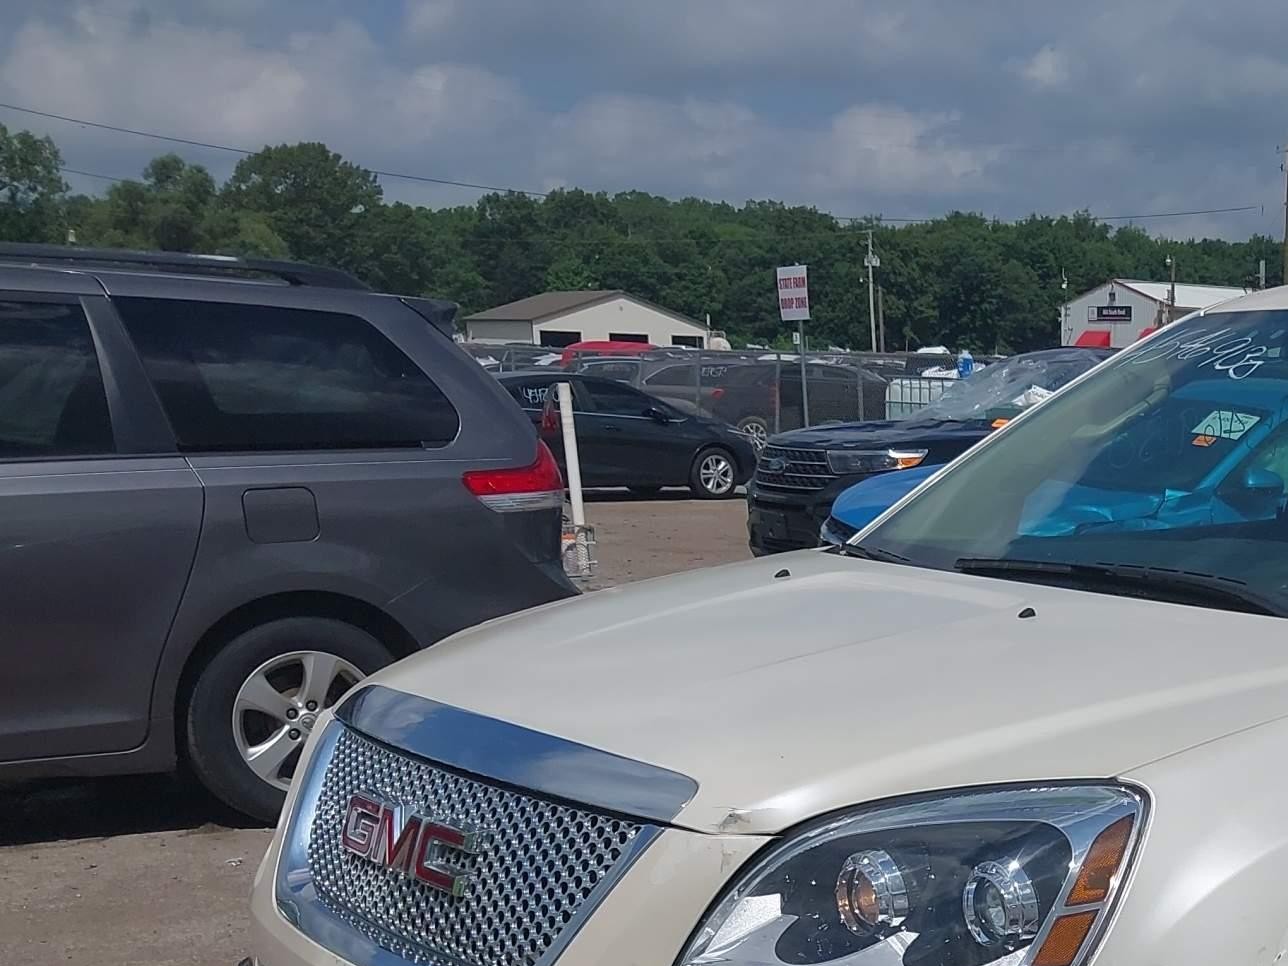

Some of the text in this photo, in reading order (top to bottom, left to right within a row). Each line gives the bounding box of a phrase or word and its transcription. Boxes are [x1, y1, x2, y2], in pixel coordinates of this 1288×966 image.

[779, 276, 806, 289] STATE FARM
[781, 296, 807, 309] DROP ZONE
[342, 792, 472, 897] GMC
